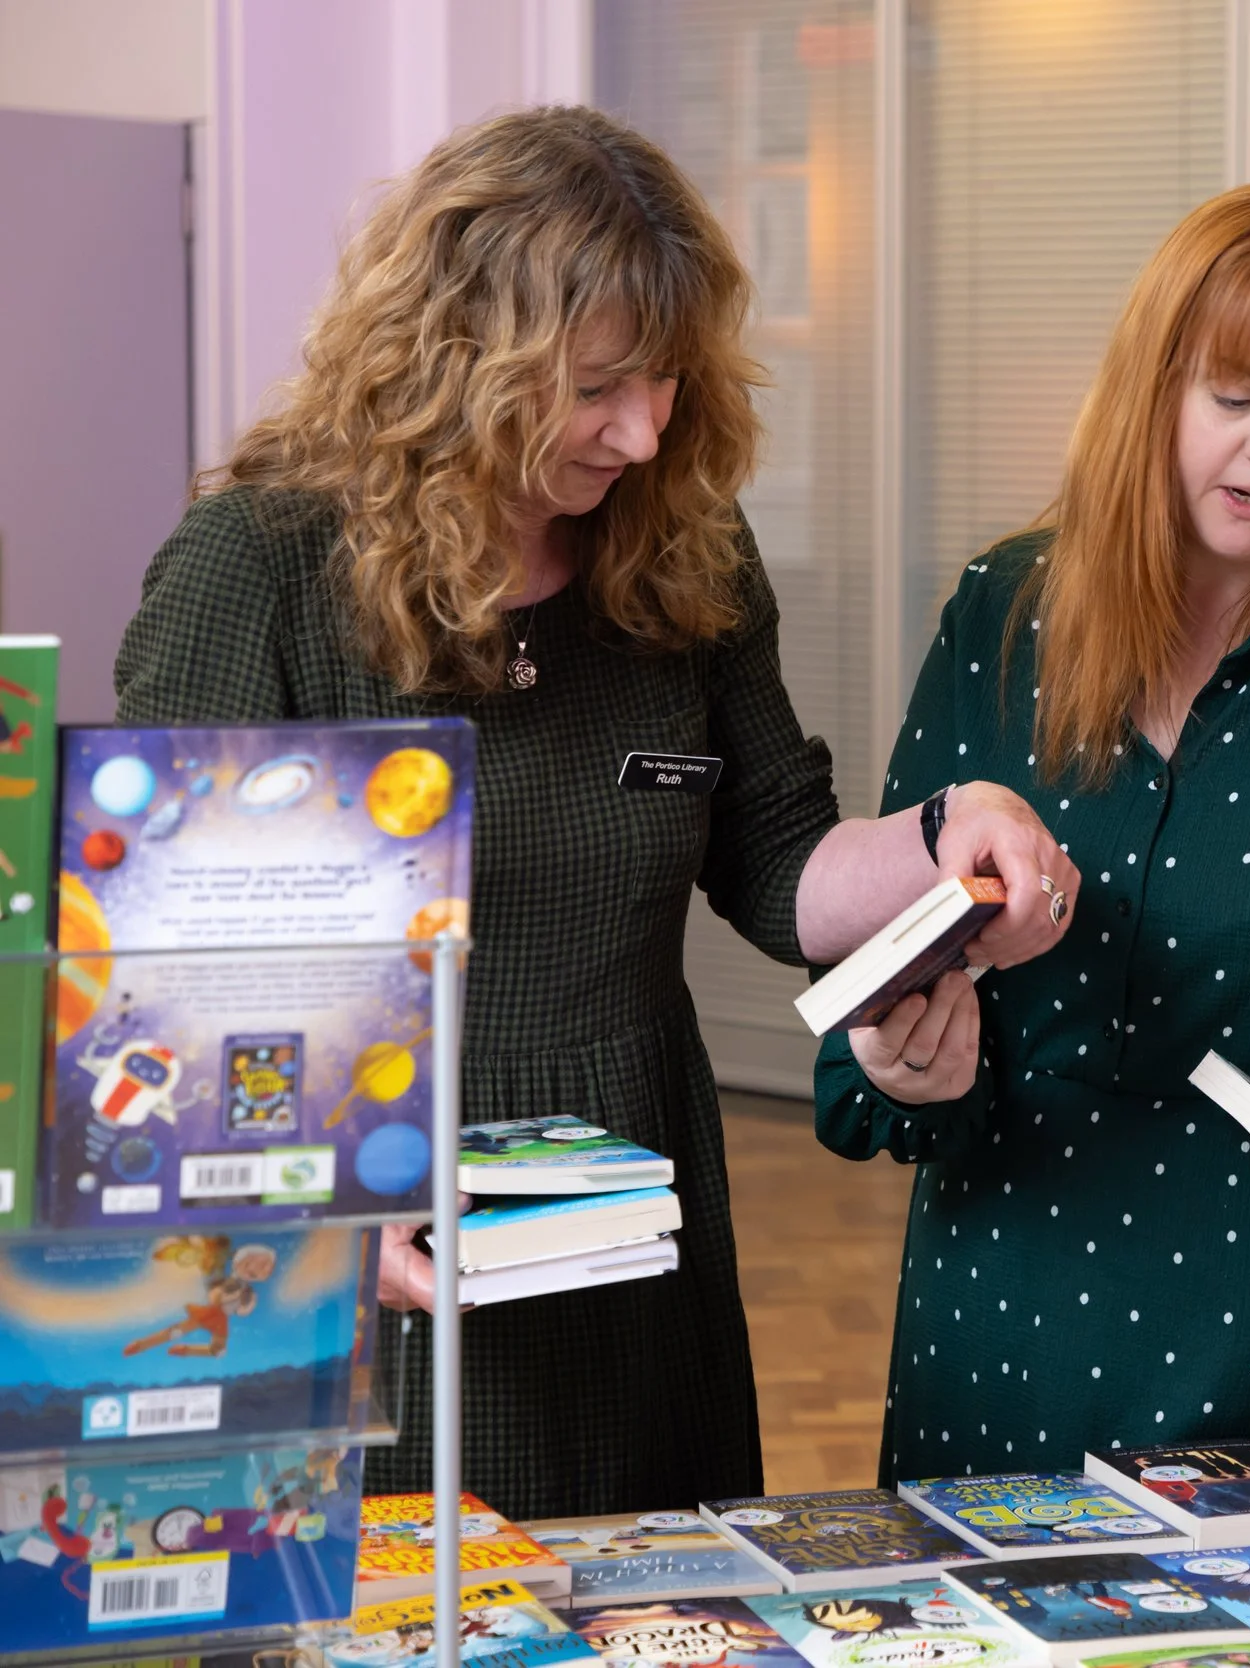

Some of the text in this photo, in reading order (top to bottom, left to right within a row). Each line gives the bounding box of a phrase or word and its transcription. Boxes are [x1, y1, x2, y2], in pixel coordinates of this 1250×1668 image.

[641, 761, 707, 774] The Portico Library
[656, 773, 682, 785] Ruth
[945, 1479, 1054, 1495] ZOMBIES
[957, 1496, 1142, 1526] BOB
[1165, 1548, 1244, 1559] NIMMO
[578, 1571, 604, 1582] IN
[600, 1621, 736, 1648] DRAGON
[852, 1649, 946, 1665] Children
